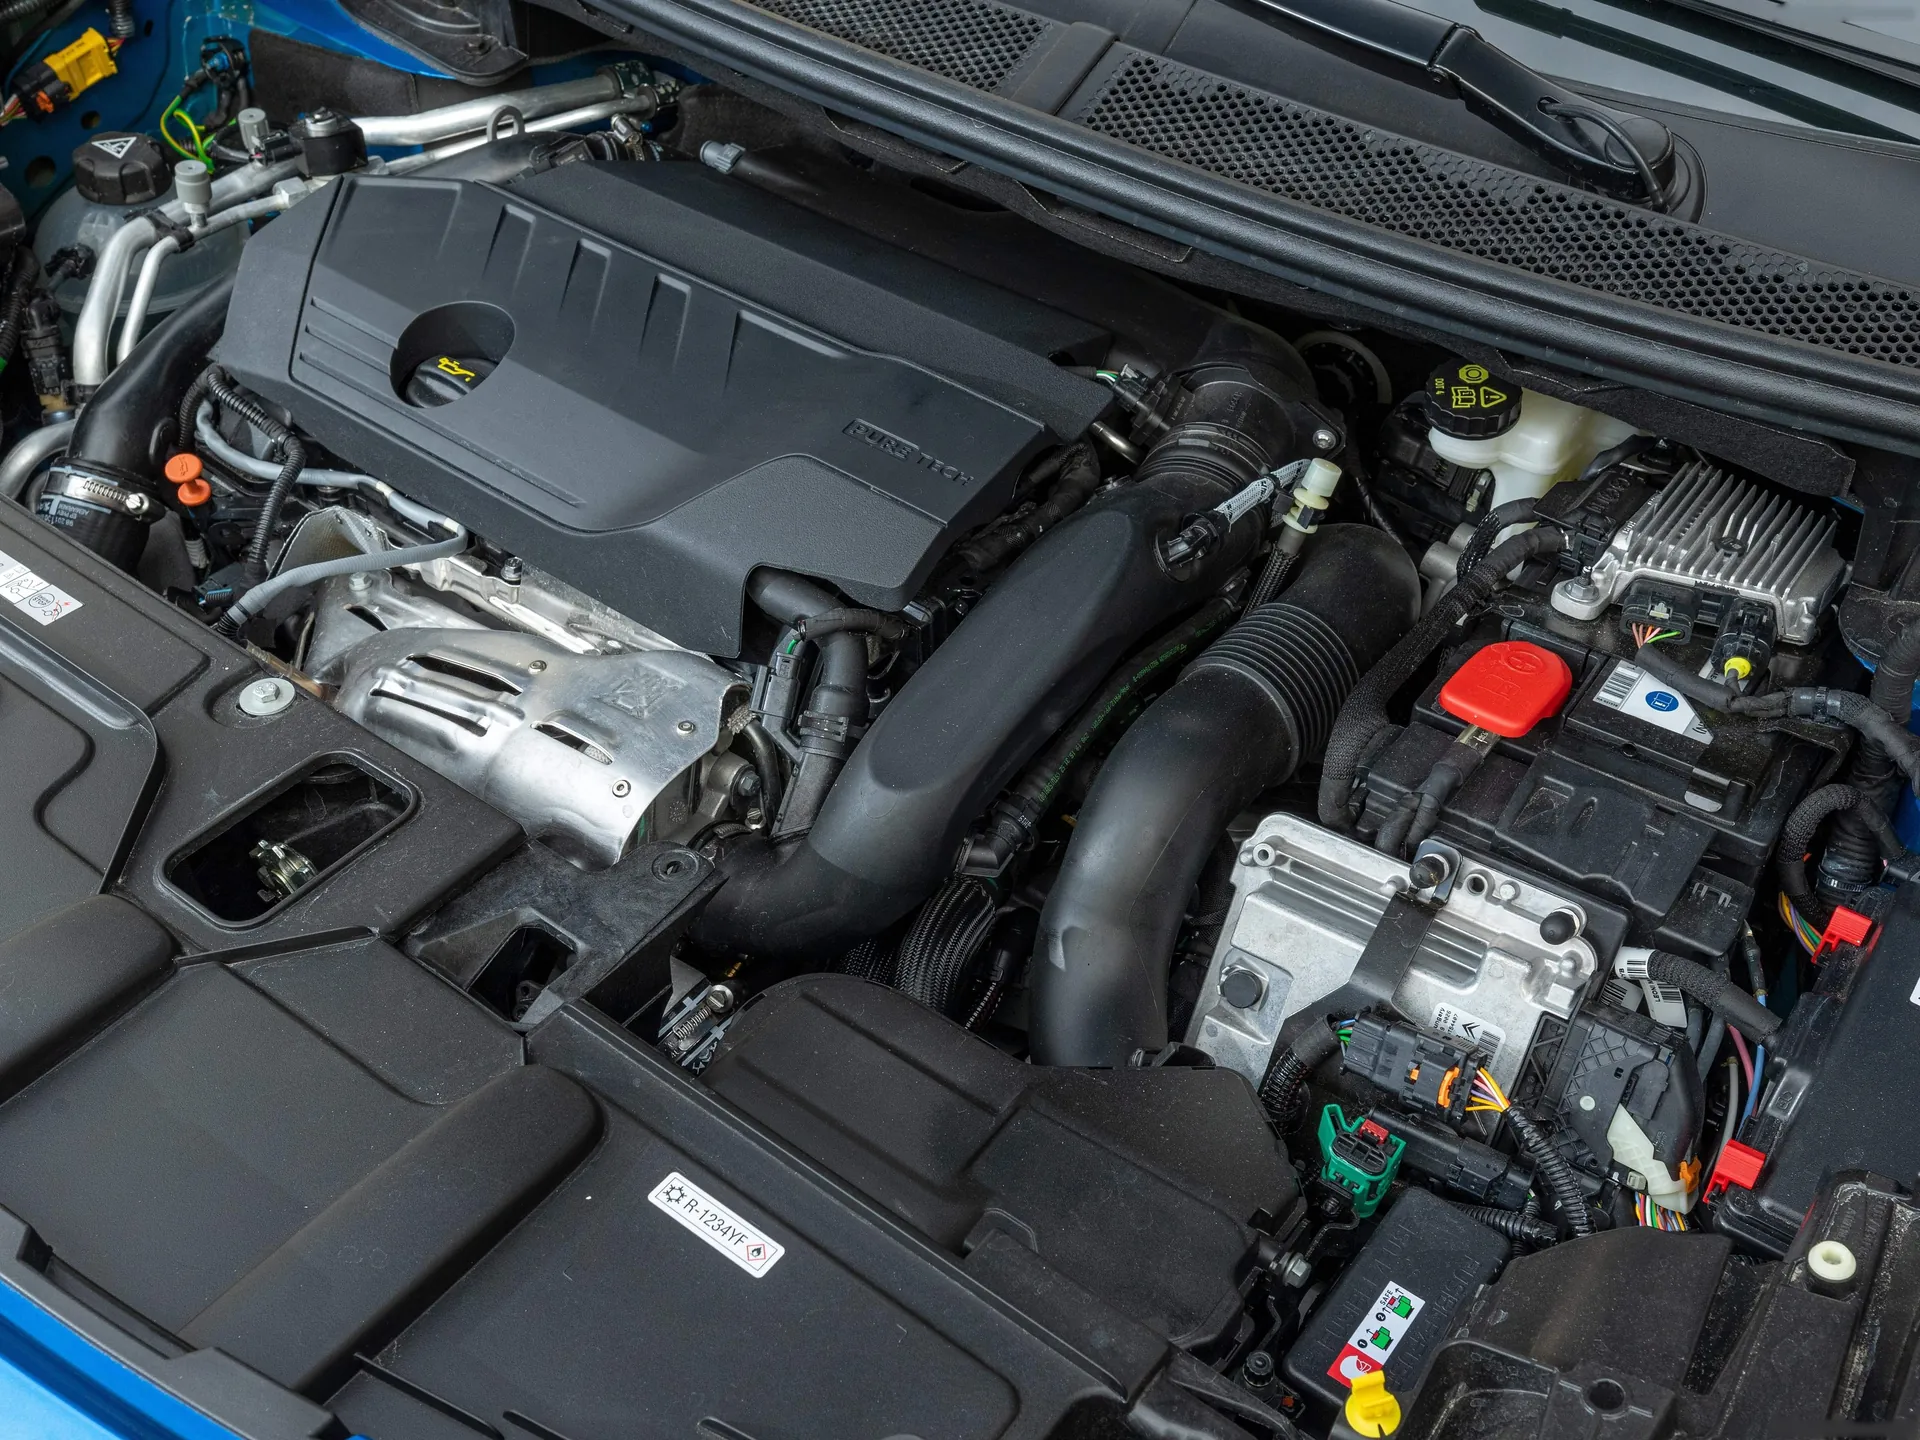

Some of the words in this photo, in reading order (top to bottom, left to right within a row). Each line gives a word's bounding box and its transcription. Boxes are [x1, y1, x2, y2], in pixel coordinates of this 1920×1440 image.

[849, 424, 914, 460] PURE
[916, 452, 975, 486] TECH
[1433, 1007, 1446, 1029] ungary
[683, 1198, 749, 1246] R-1234YF
[1379, 1289, 1393, 1305] SAFE
